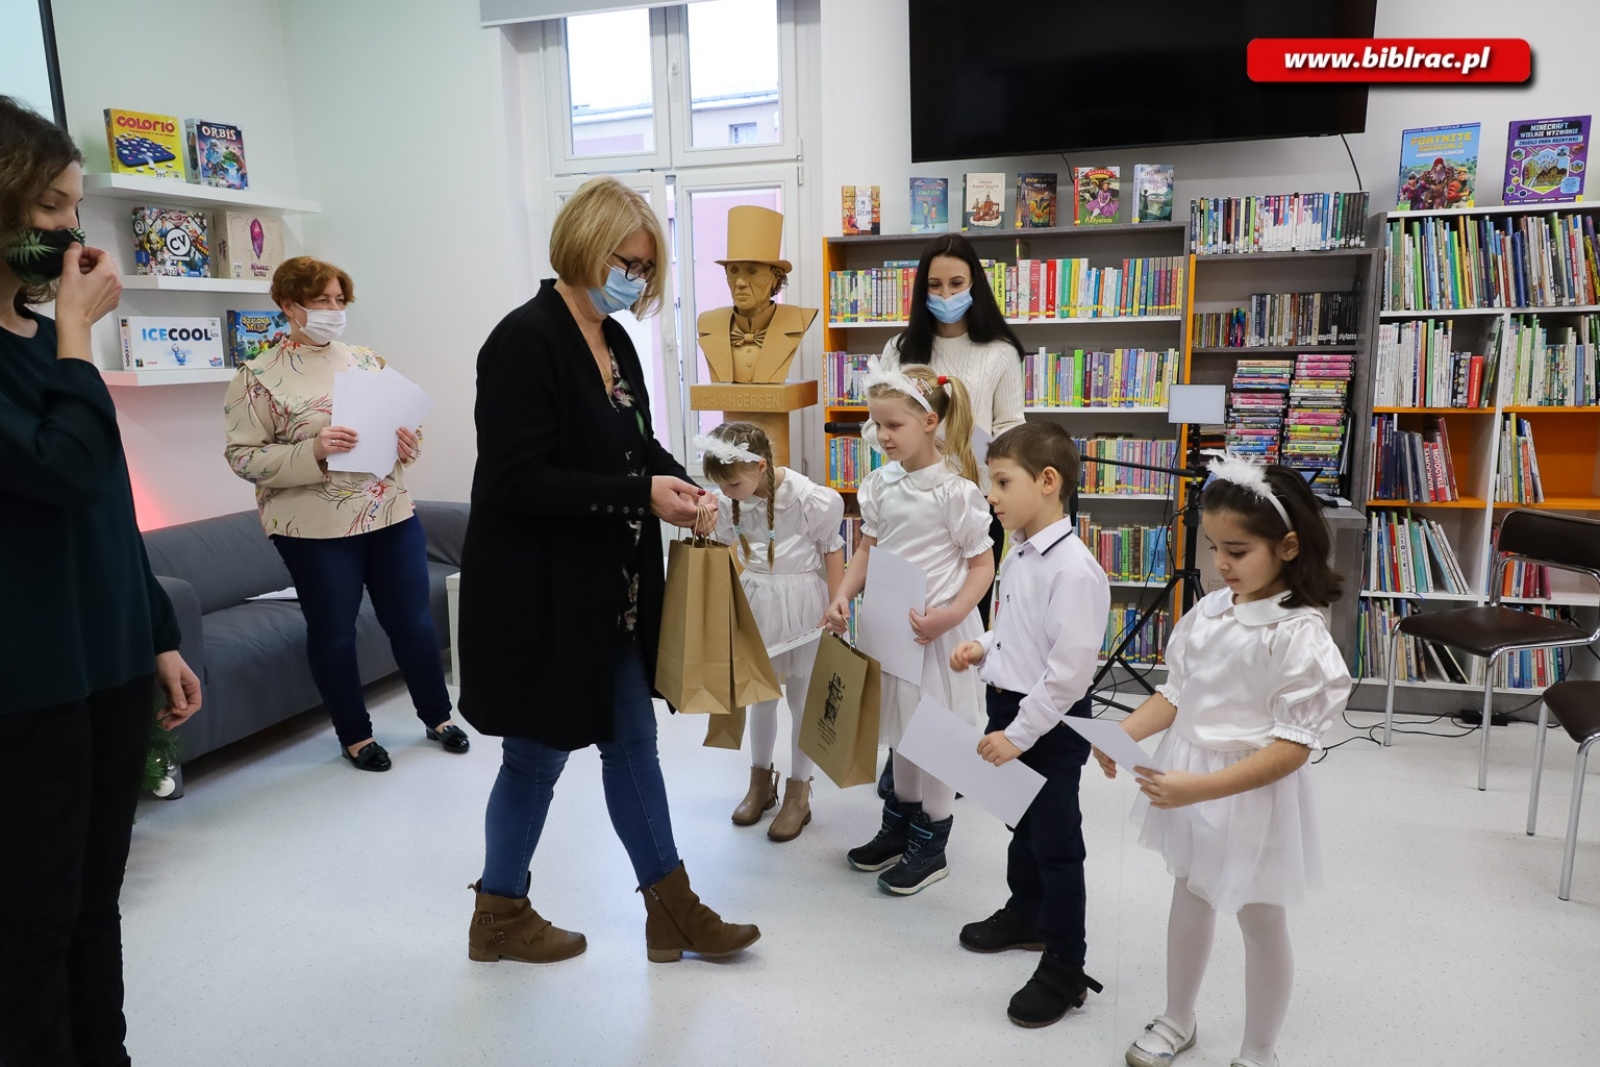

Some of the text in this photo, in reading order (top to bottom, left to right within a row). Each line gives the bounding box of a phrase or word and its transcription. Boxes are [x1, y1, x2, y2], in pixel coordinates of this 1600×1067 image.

[1520, 128, 1579, 138] WIELKIE WYZWANIE
[1530, 122, 1569, 131] MINECRAFT
[1410, 131, 1473, 147] FORTNITE
[169, 234, 187, 251] CV
[722, 393, 780, 408] ANDERSEN
[1432, 448, 1445, 489] MOTOCYKLE
